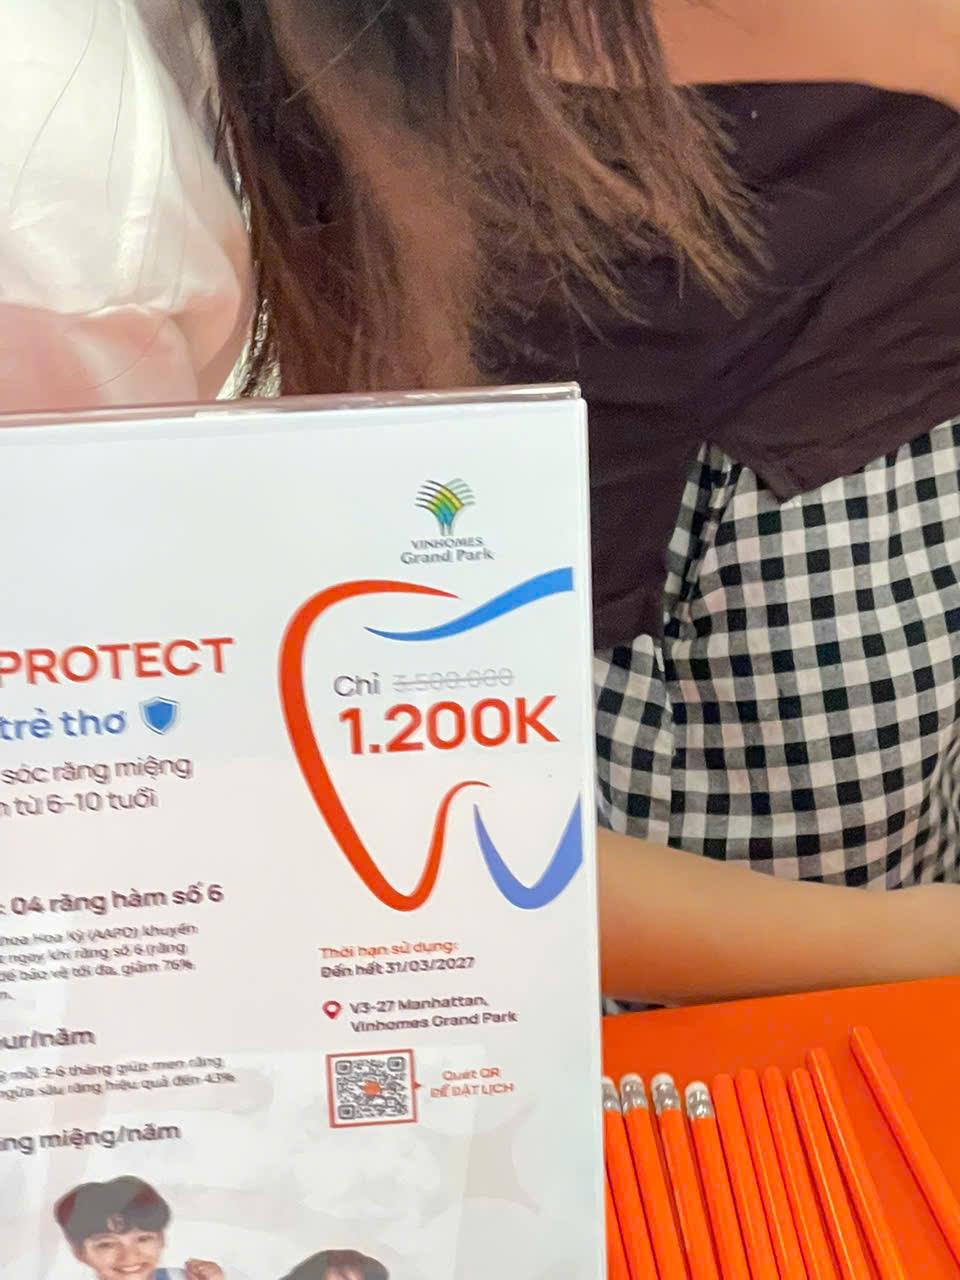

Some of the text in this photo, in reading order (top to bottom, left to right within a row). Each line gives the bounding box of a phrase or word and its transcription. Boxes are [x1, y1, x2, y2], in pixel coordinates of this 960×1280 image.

[400, 547, 495, 565] Grand Park
[411, 536, 484, 550] VINHOMES
[0, 637, 234, 687] PROTECT
[333, 672, 381, 698] Chỉ
[59, 708, 127, 737] thơ
[338, 695, 561, 755] 1.200K
[52, 761, 111, 785] răng
[114, 755, 193, 780] miệng
[106, 786, 159, 810] tuổi
[49, 894, 107, 916] răng
[111, 888, 167, 909] hàm
[172, 881, 204, 905] số
[207, 883, 225, 903] 6
[321, 957, 475, 978] Đến hết 31/03/2027
[350, 1010, 518, 1033] Vinhomes Grand Park
